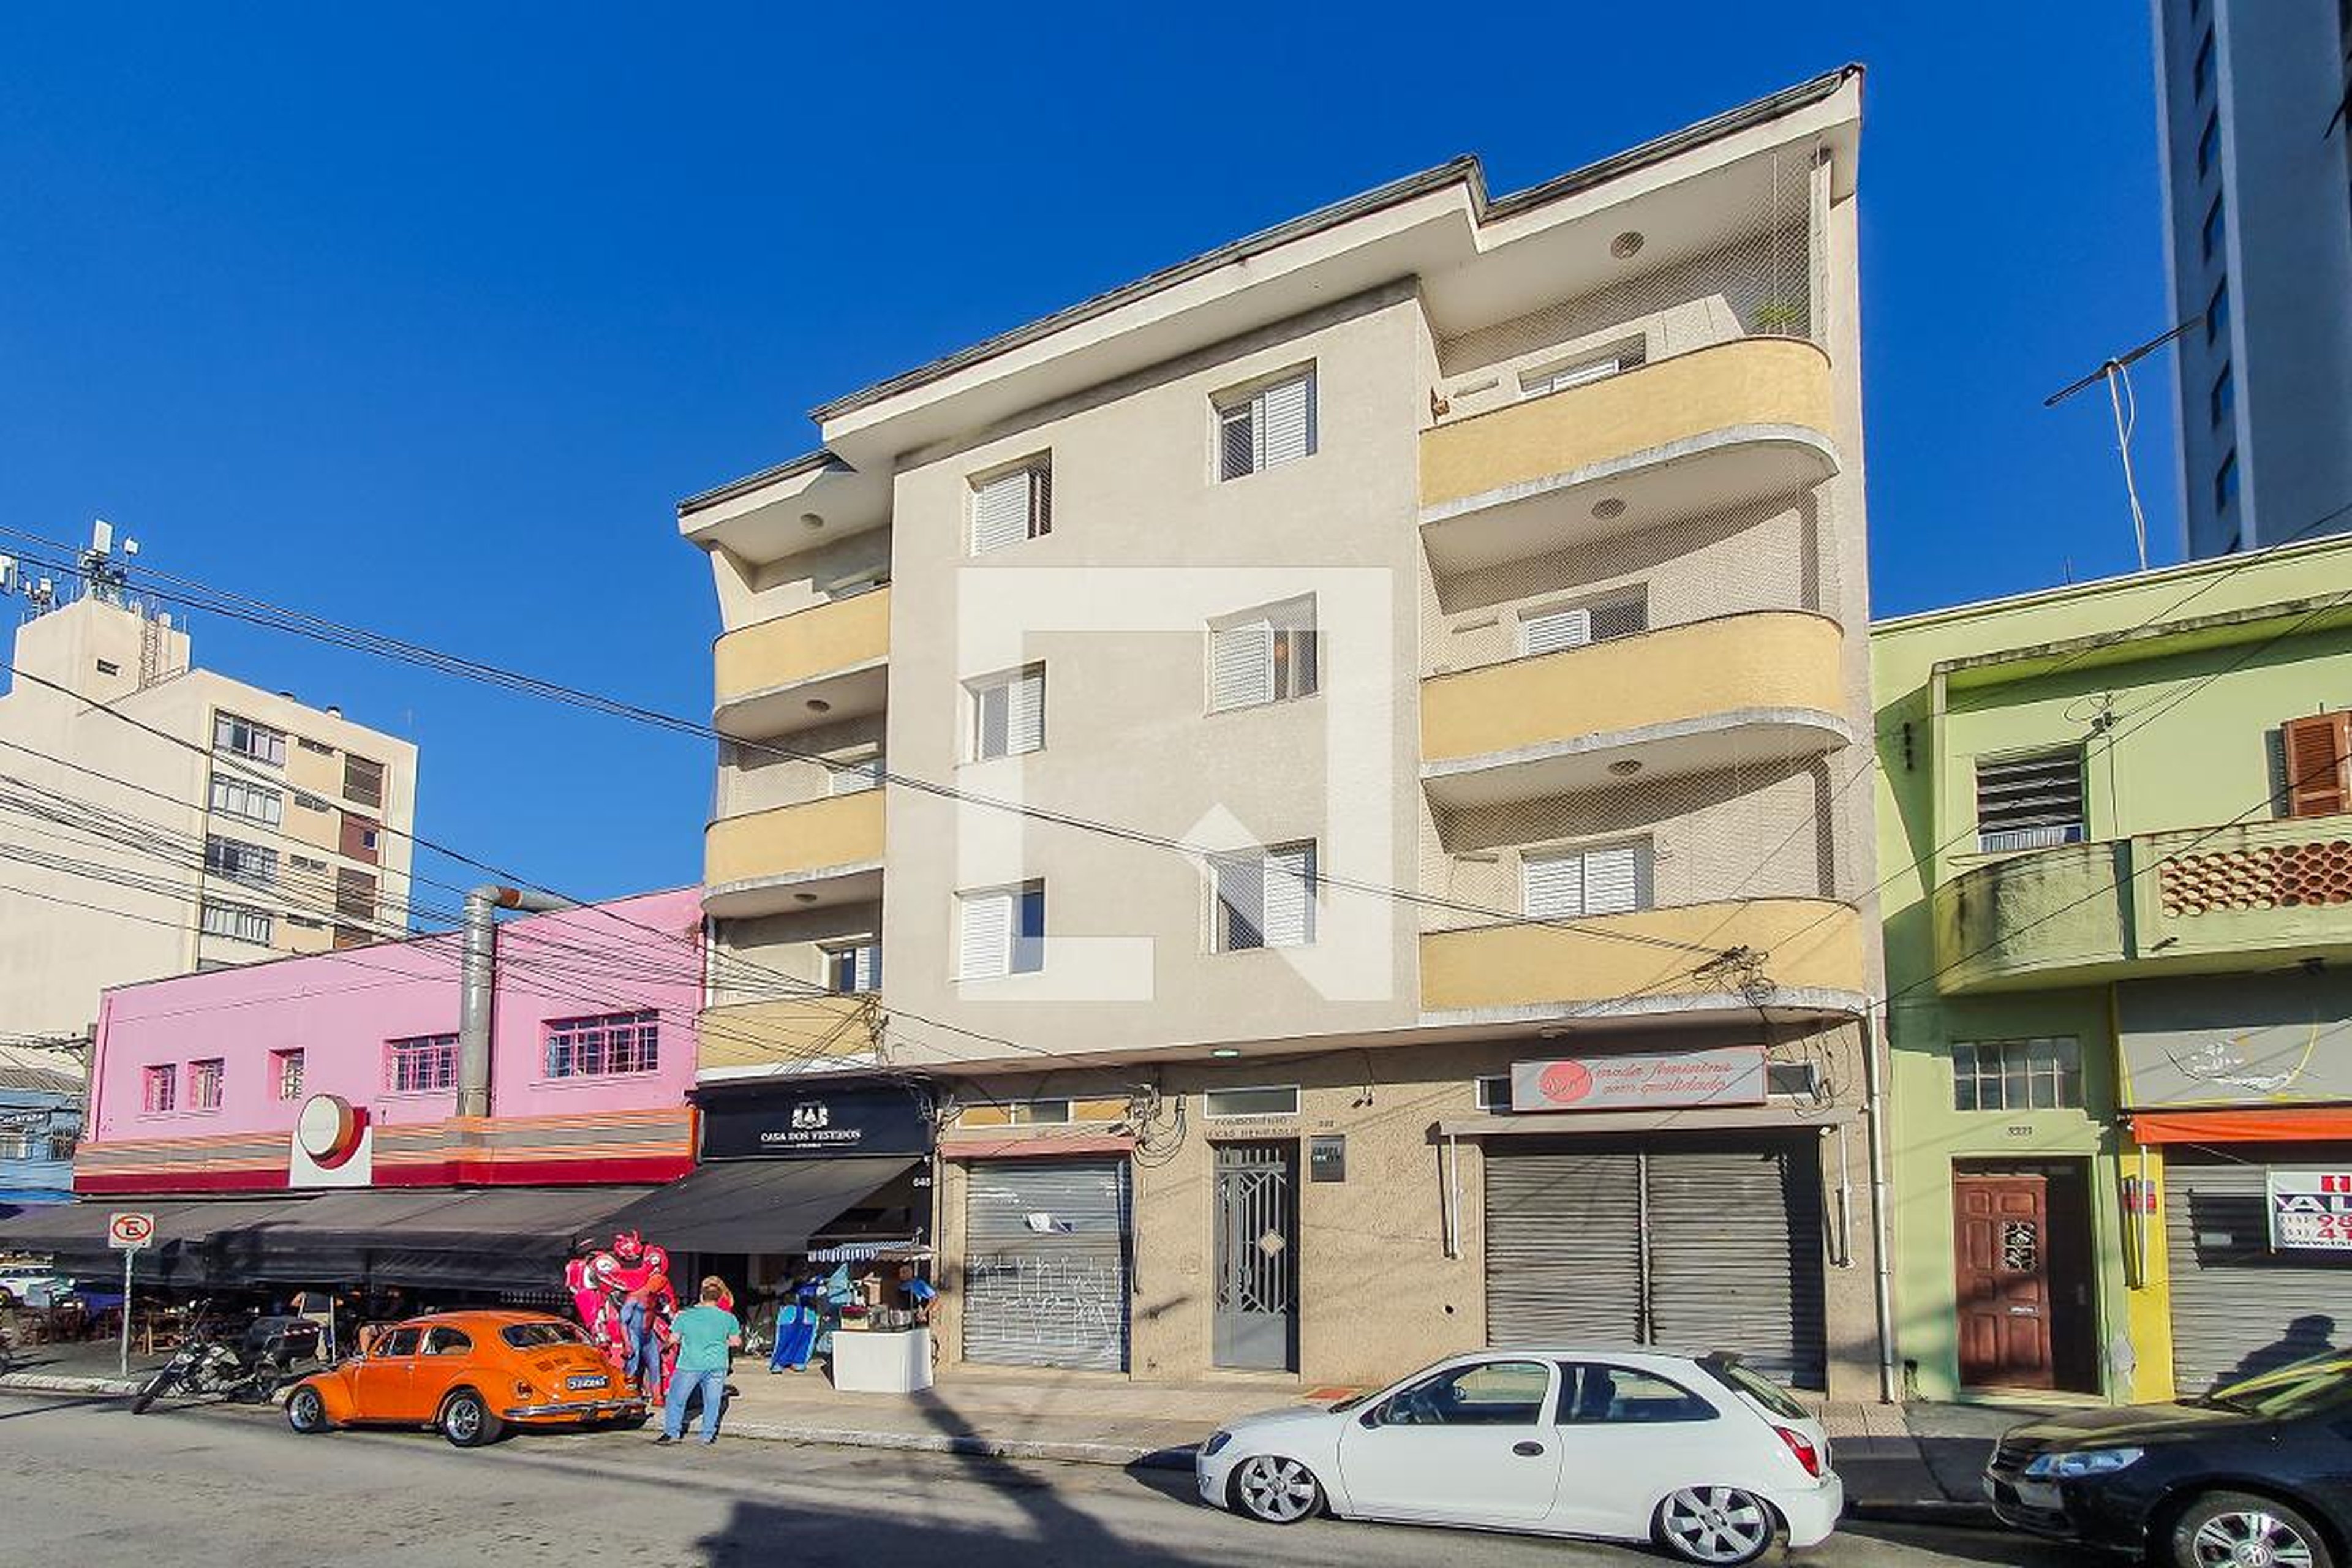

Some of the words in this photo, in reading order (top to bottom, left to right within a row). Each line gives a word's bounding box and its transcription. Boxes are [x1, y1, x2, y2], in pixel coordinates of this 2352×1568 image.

[760, 1132, 786, 1142] CASA
[788, 1131, 809, 1141] DOS
[810, 1129, 862, 1140] VESTIDOS
